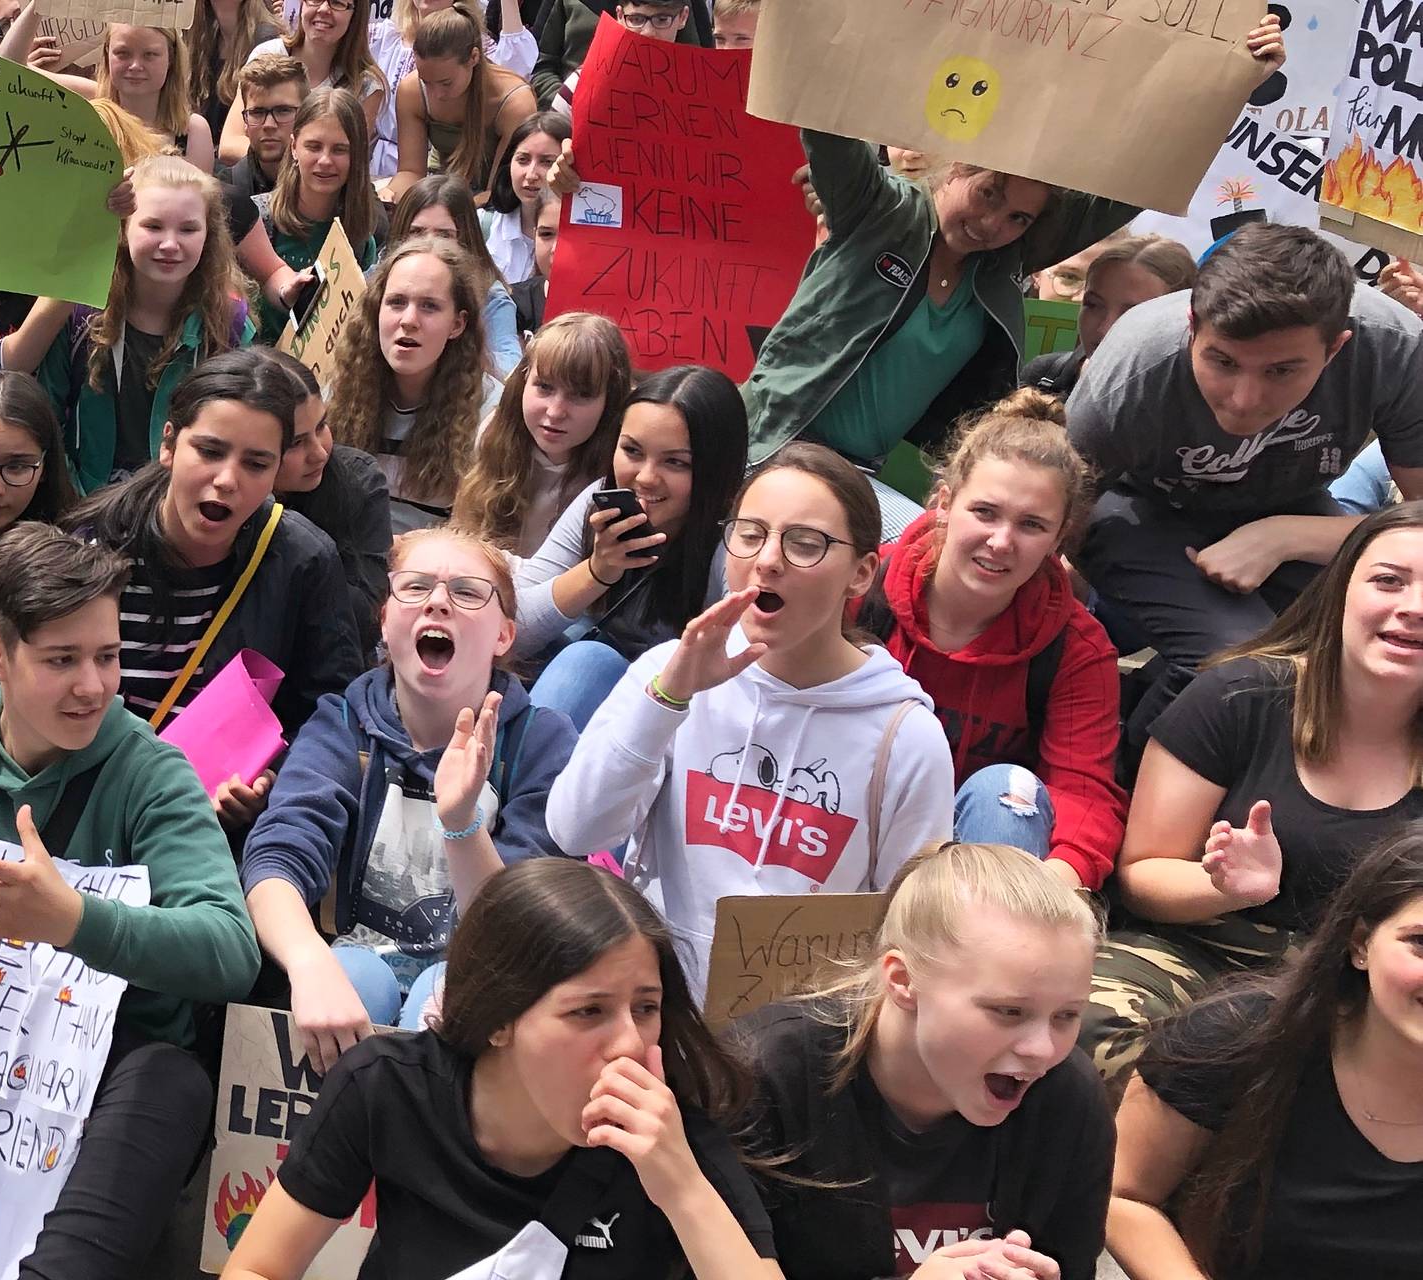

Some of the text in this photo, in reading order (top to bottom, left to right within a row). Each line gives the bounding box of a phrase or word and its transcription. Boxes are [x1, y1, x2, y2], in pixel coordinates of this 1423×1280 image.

[595, 38, 746, 104] WARUM
[1349, 30, 1423, 101] POL
[587, 86, 739, 139] LERNEN
[587, 132, 750, 191] WENN WIR
[631, 181, 750, 243] KEINE
[581, 241, 780, 314] ZUKUNFT
[325, 289, 355, 354] auch
[607, 306, 727, 365] ABEN
